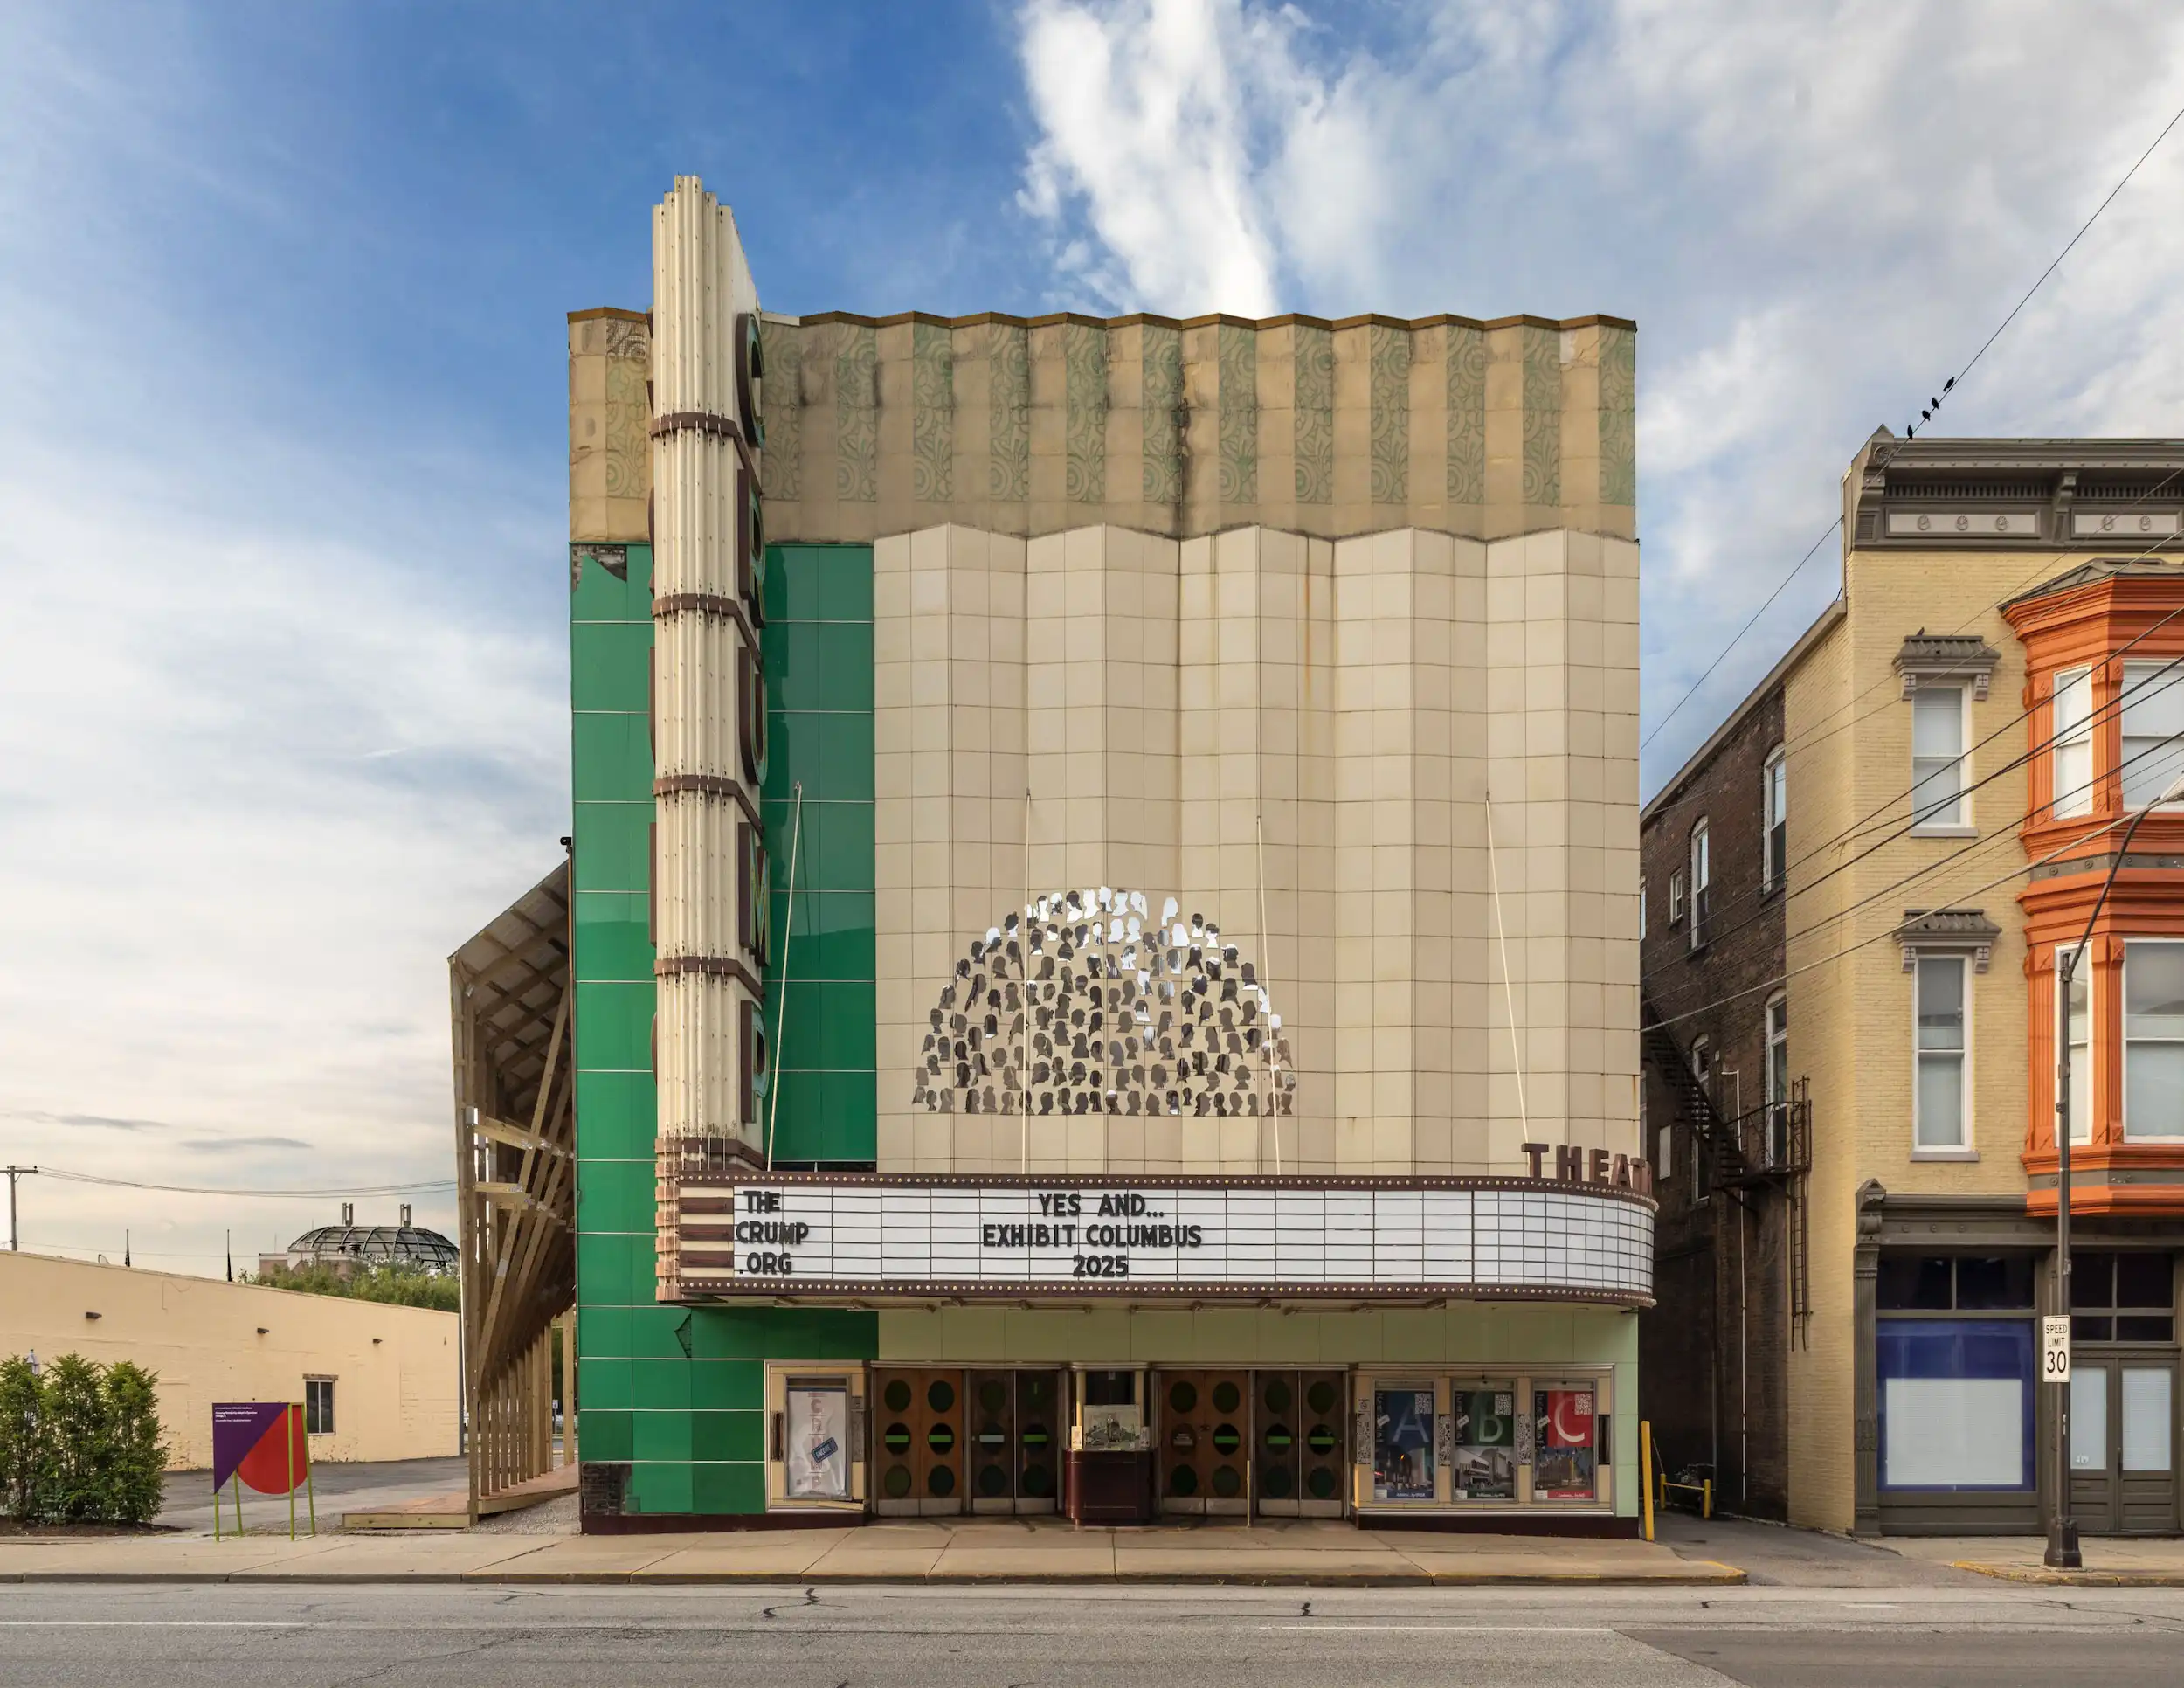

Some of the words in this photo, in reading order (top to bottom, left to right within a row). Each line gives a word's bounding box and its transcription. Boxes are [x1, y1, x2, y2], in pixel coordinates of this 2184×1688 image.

[736, 311, 771, 1124] CRUMP
[743, 1191, 780, 1214] THE
[1038, 1193, 1082, 1217] YES
[1097, 1193, 1165, 1218] AND...
[736, 1221, 809, 1245] CRUMP
[983, 1224, 1076, 1247] EXHIBIT
[1086, 1225, 1202, 1248] COLUMBUS
[739, 1252, 792, 1275] .ORG
[1073, 1255, 1129, 1277] 2025
[2046, 1324, 2068, 1334] SPEED
[2048, 1337, 2065, 1347] LIMIT
[2046, 1350, 2067, 1373] 30
[1555, 1398, 1586, 1442] C
